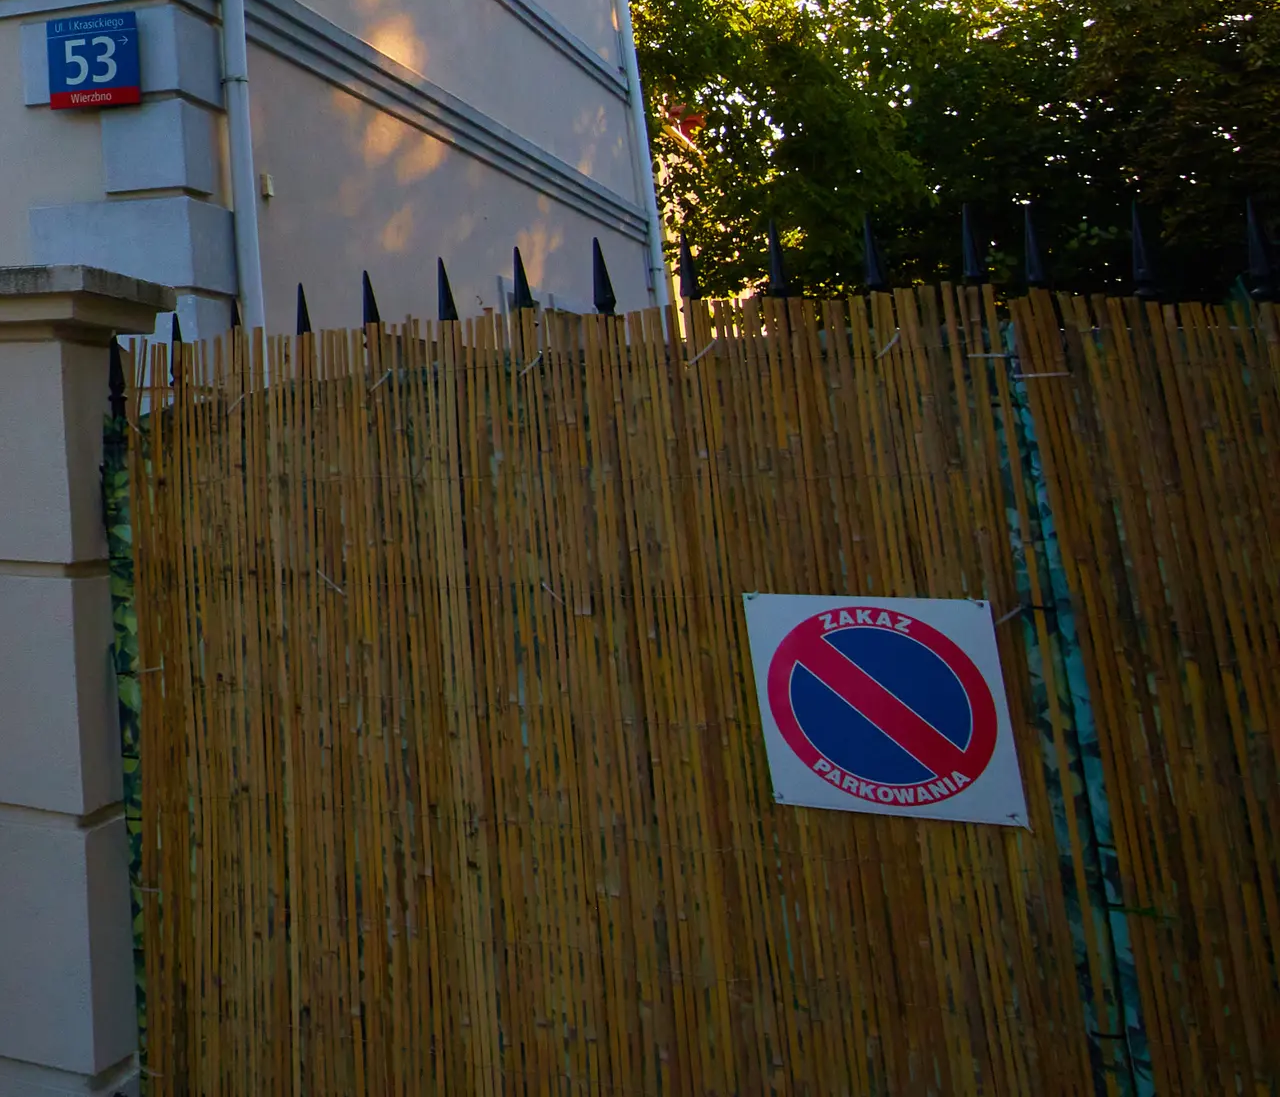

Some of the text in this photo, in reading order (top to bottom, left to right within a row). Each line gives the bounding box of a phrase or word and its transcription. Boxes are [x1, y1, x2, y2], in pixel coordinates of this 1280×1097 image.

[64, 35, 118, 86] 53
[70, 91, 112, 104] Wierzbno
[818, 608, 913, 633] ZAKAZ
[812, 757, 971, 804] PARKOWANIA
